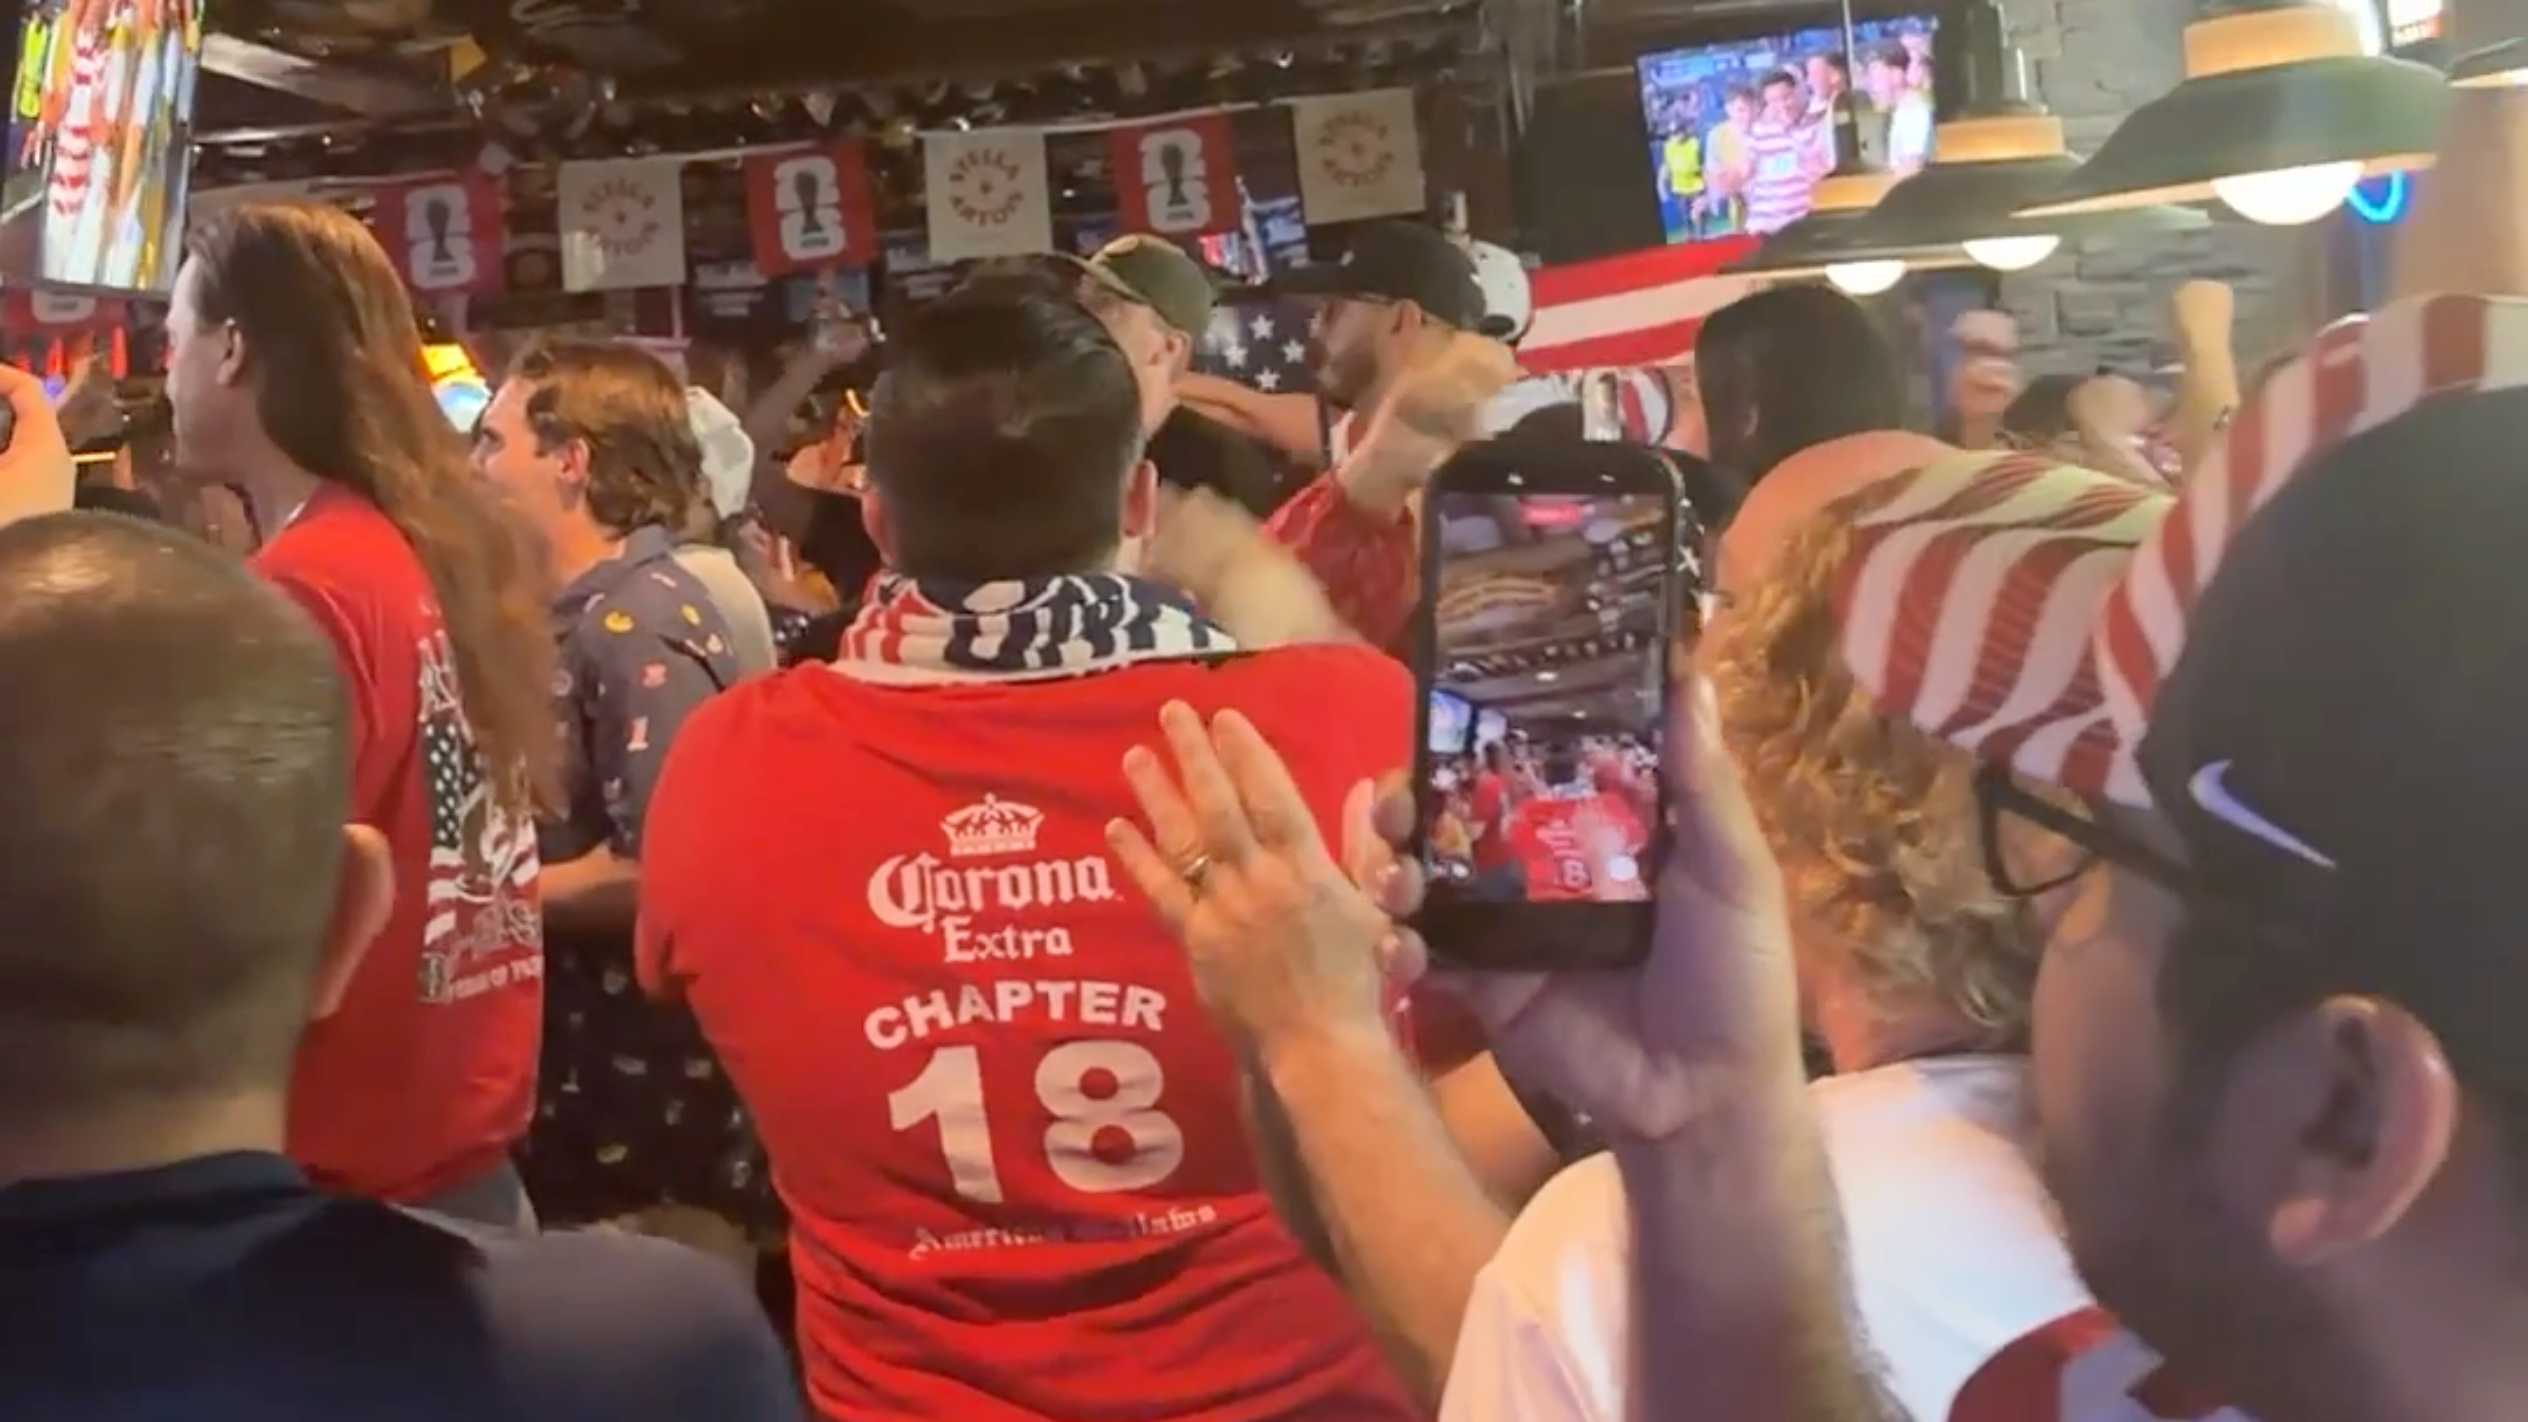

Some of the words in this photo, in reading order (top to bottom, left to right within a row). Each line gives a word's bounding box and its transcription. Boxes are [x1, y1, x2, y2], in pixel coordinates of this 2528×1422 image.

[867, 851, 1116, 934] Corona
[943, 912, 1074, 963] Extra
[864, 980, 1167, 1050] CHAPTER
[888, 1040, 1184, 1206] 18
